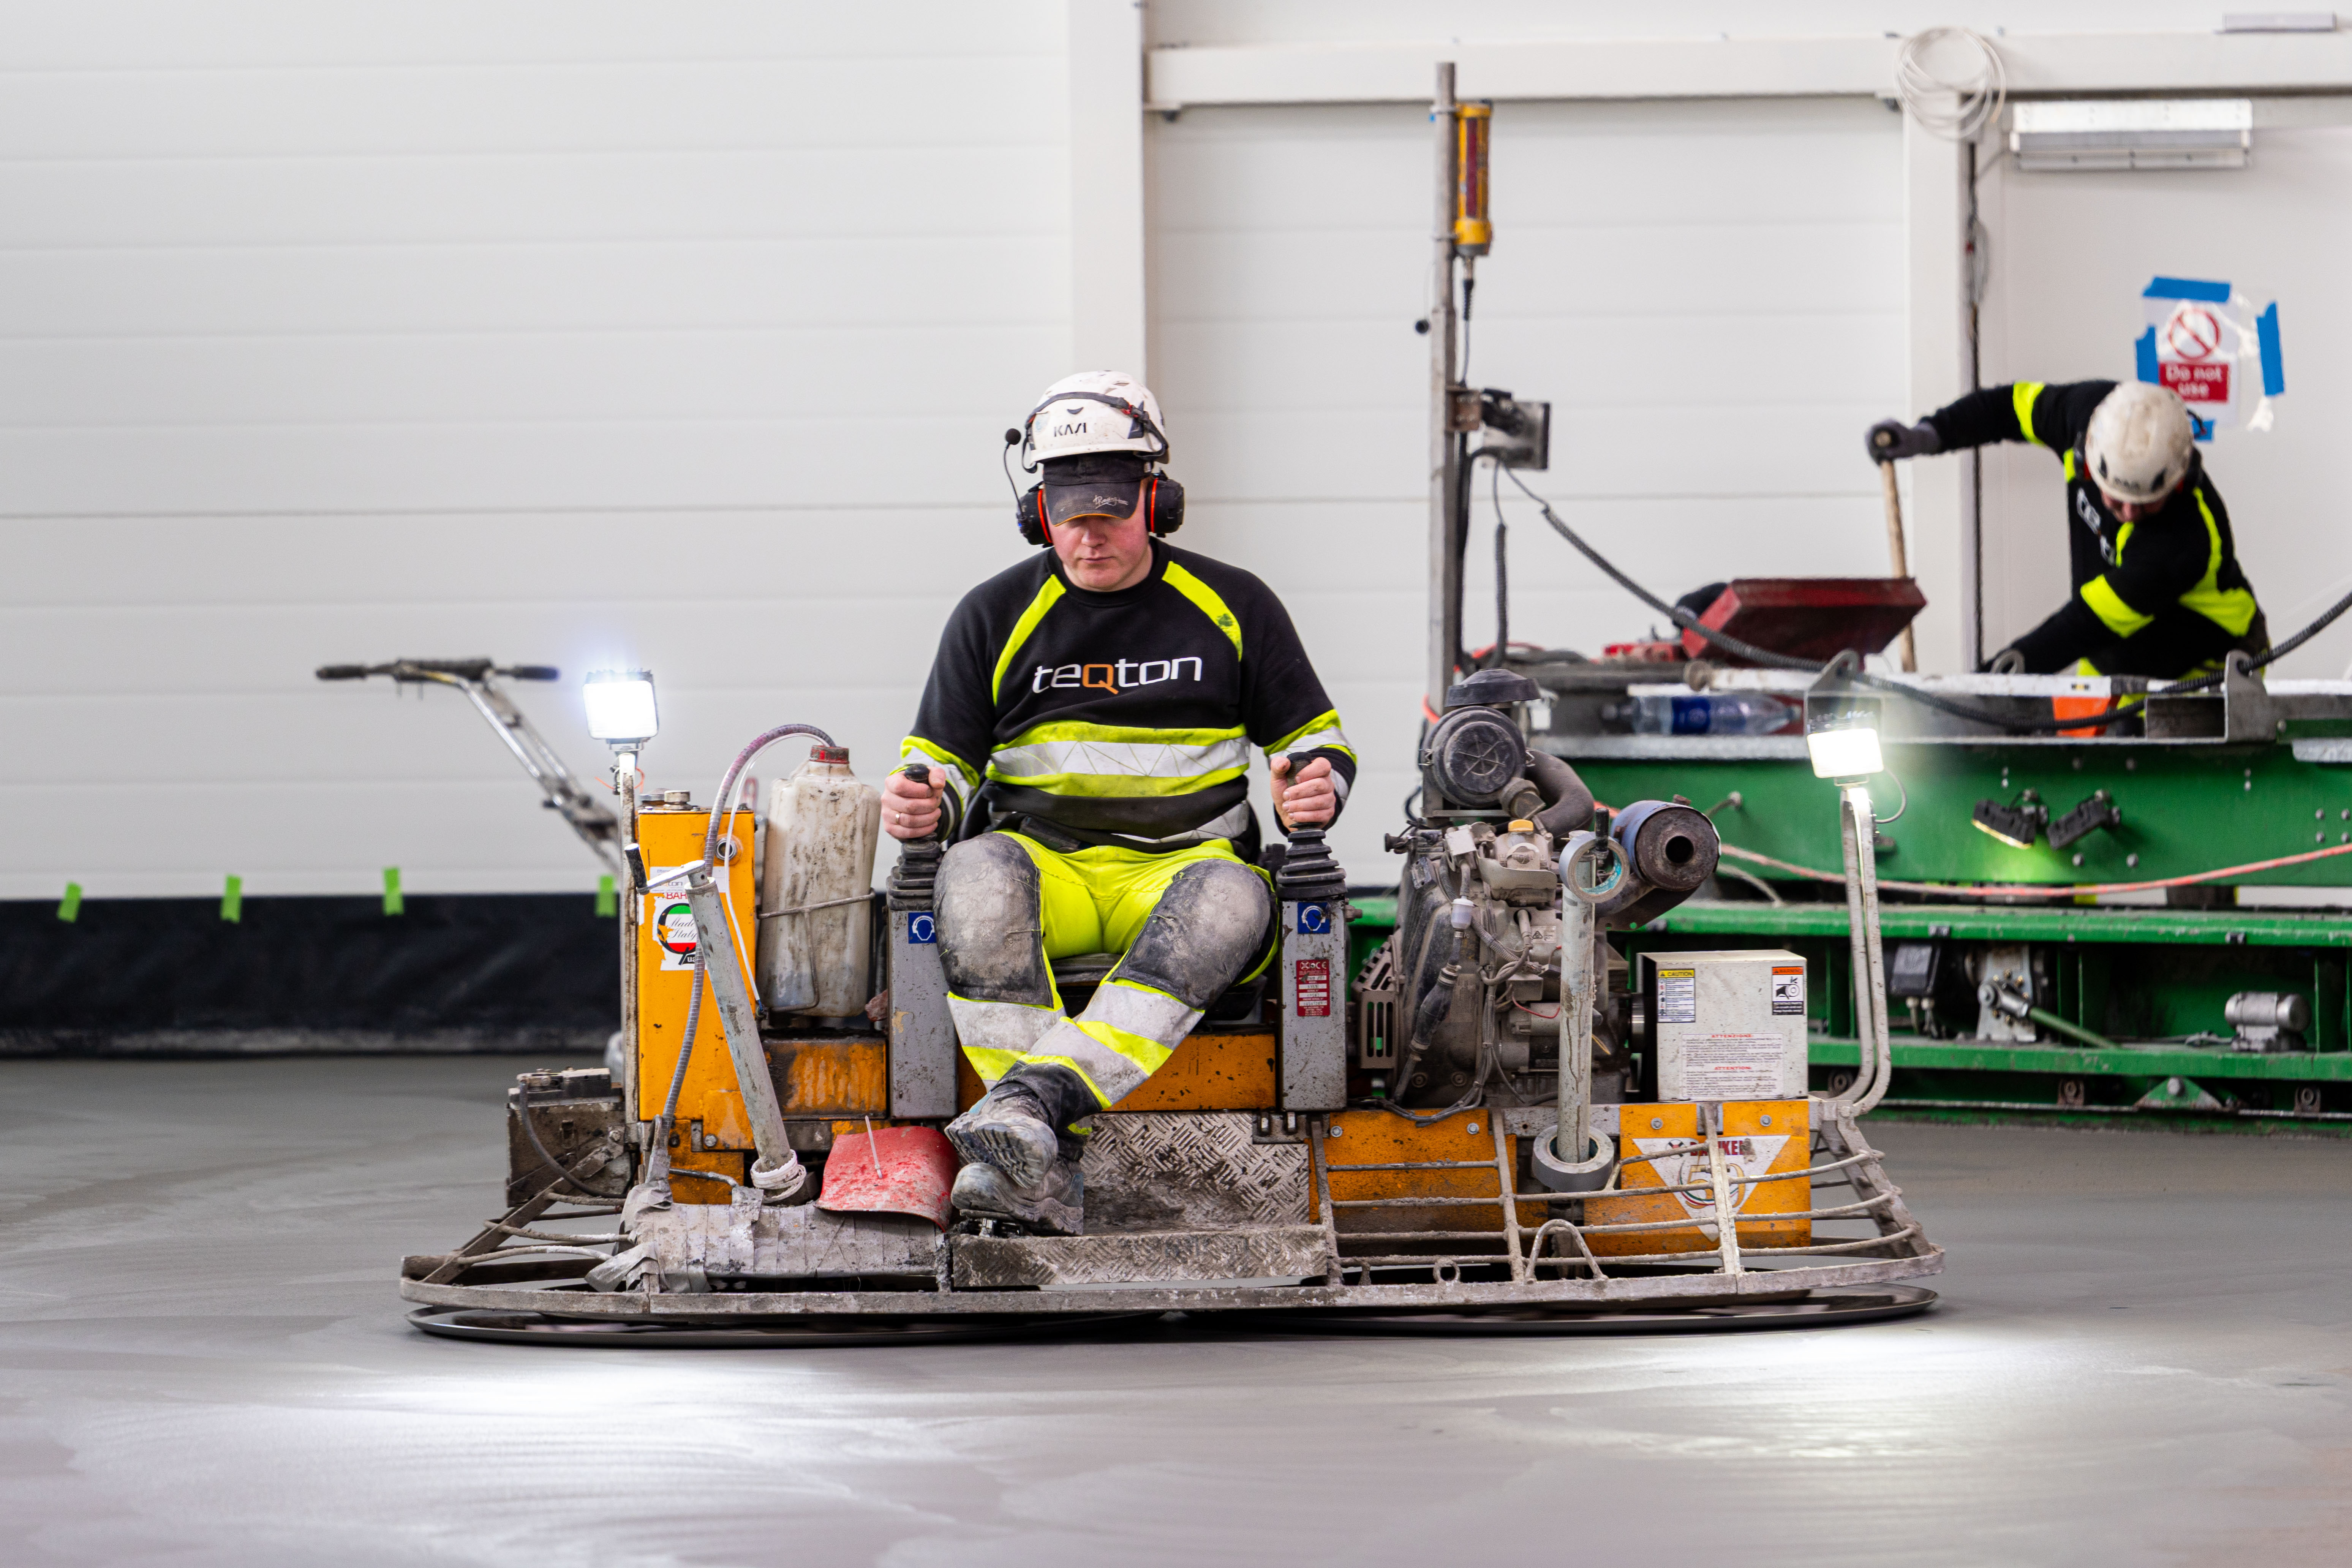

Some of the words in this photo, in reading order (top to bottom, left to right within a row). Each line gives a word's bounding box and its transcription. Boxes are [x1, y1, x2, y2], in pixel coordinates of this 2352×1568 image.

[2166, 365, 2191, 382] Do
[2193, 366, 2221, 382] not
[2178, 381, 2209, 397] use
[1032, 657, 1202, 694] teQton
